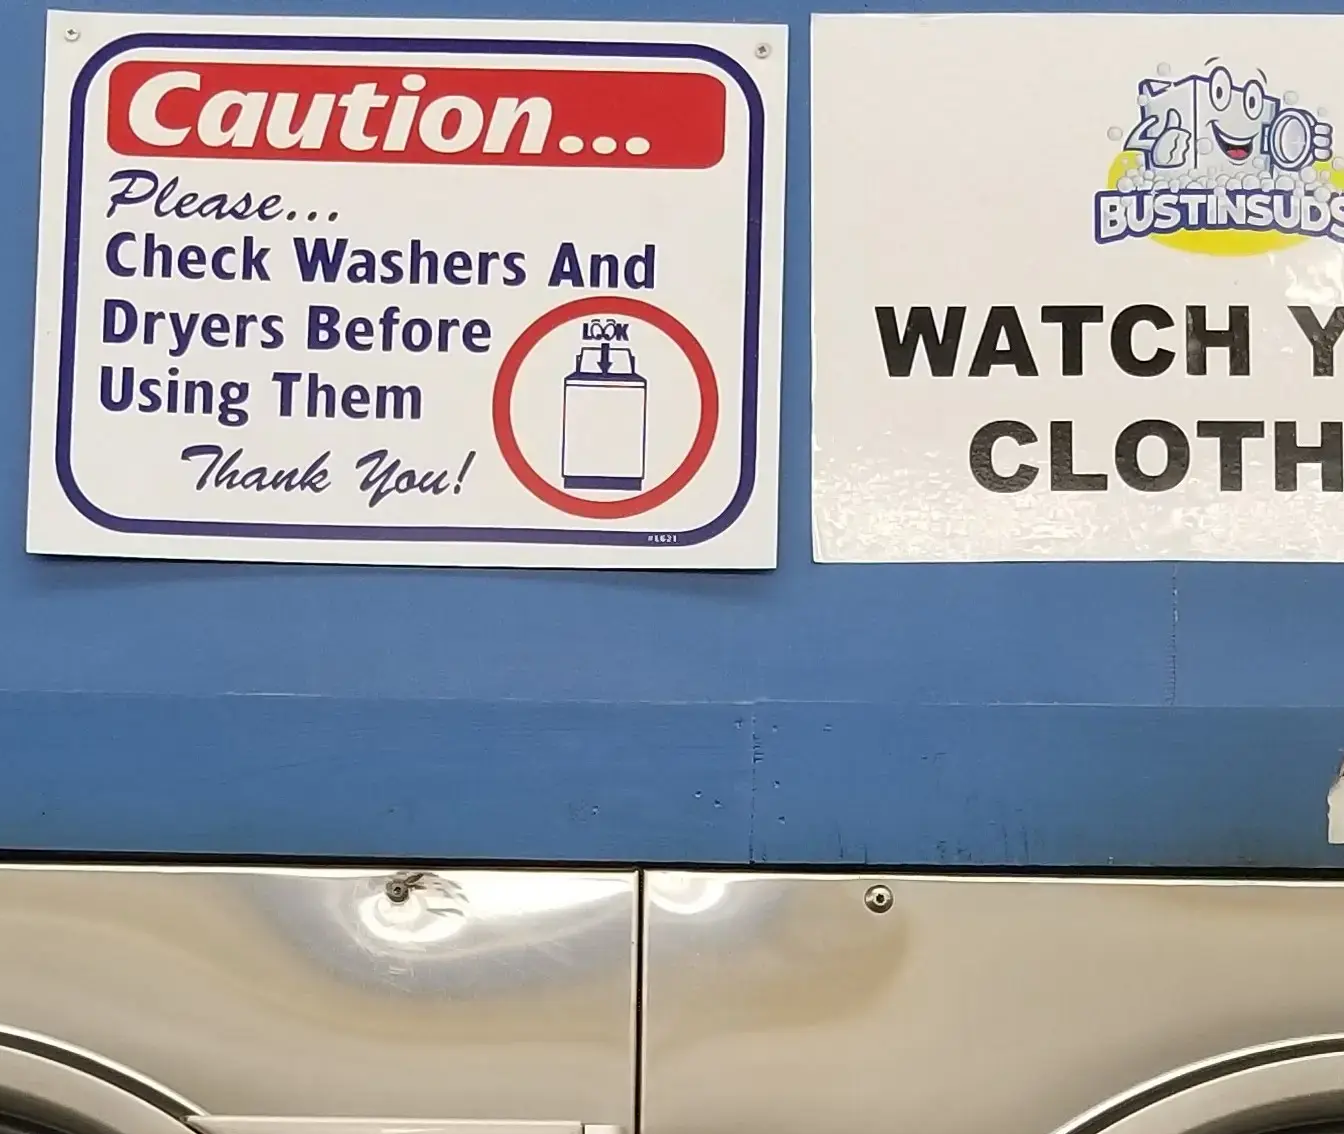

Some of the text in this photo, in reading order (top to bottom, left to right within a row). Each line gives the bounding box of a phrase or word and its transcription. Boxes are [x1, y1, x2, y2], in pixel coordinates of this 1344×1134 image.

[127, 70, 651, 155] Caution...
[106, 168, 339, 222] Please...
[105, 231, 656, 290] Check Washers And
[102, 298, 492, 357] Dryers Before
[582, 321, 629, 341] LOOK
[874, 303, 1252, 378] WATCH
[100, 365, 422, 427] Using Them
[180, 444, 477, 508] Thank You!
